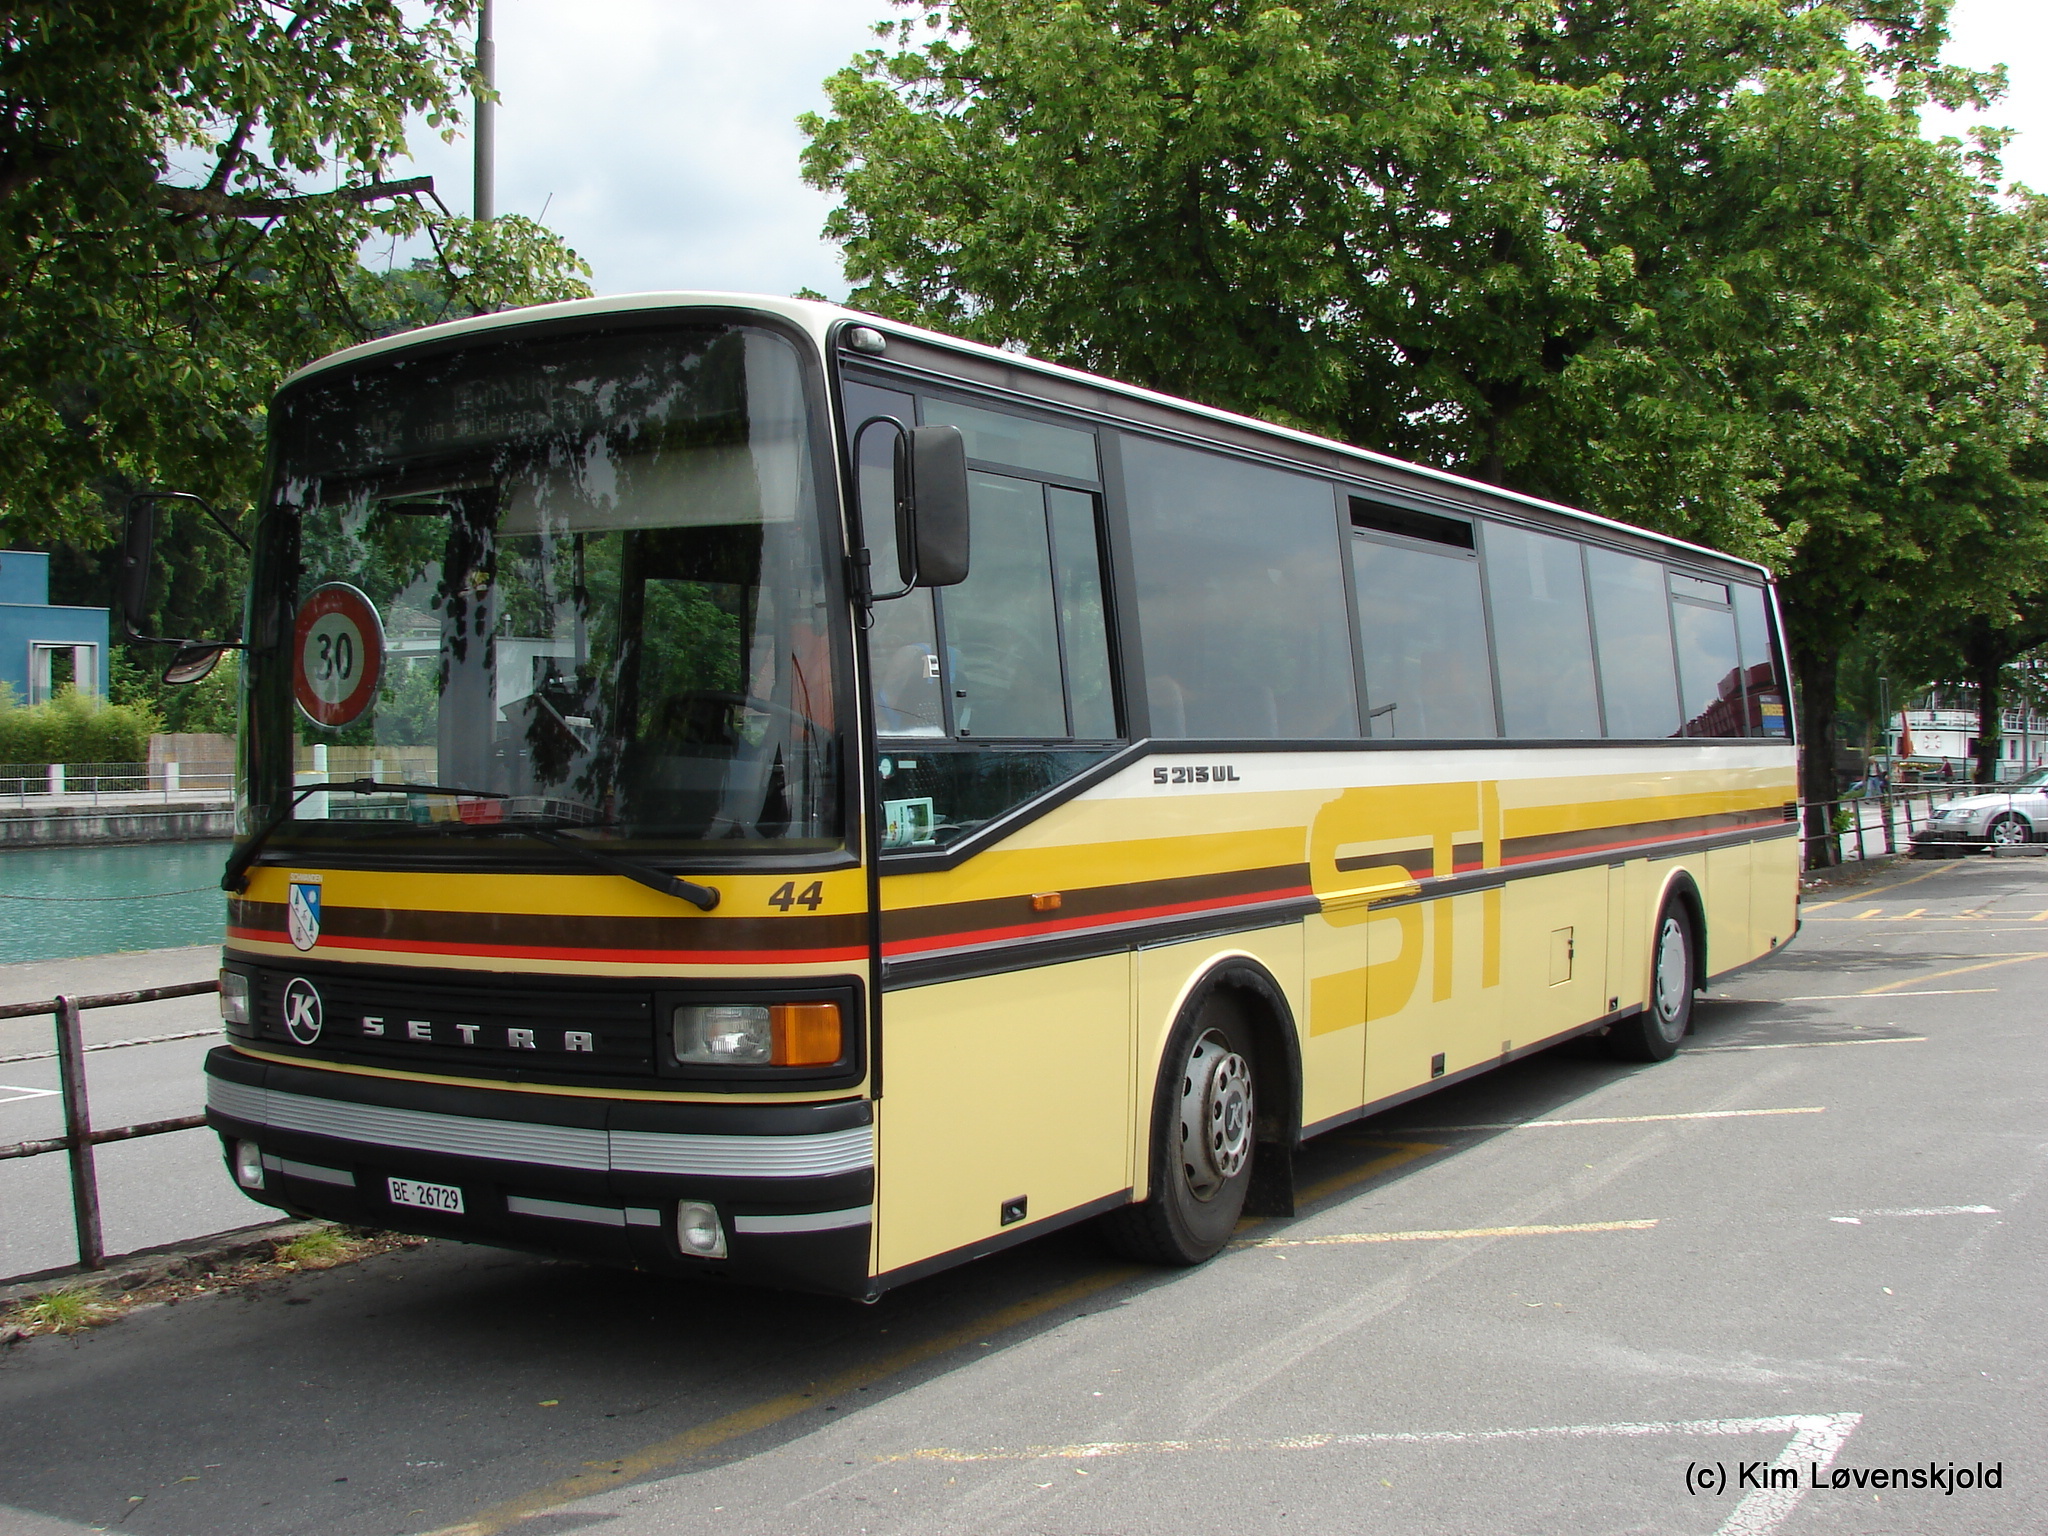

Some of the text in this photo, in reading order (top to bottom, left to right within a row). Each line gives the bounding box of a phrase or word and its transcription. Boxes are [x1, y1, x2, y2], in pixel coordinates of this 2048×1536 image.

[315, 632, 353, 681] 30
[768, 881, 823, 911] 44
[1310, 780, 1501, 1037] STI
[362, 1016, 594, 1052] SETRA
